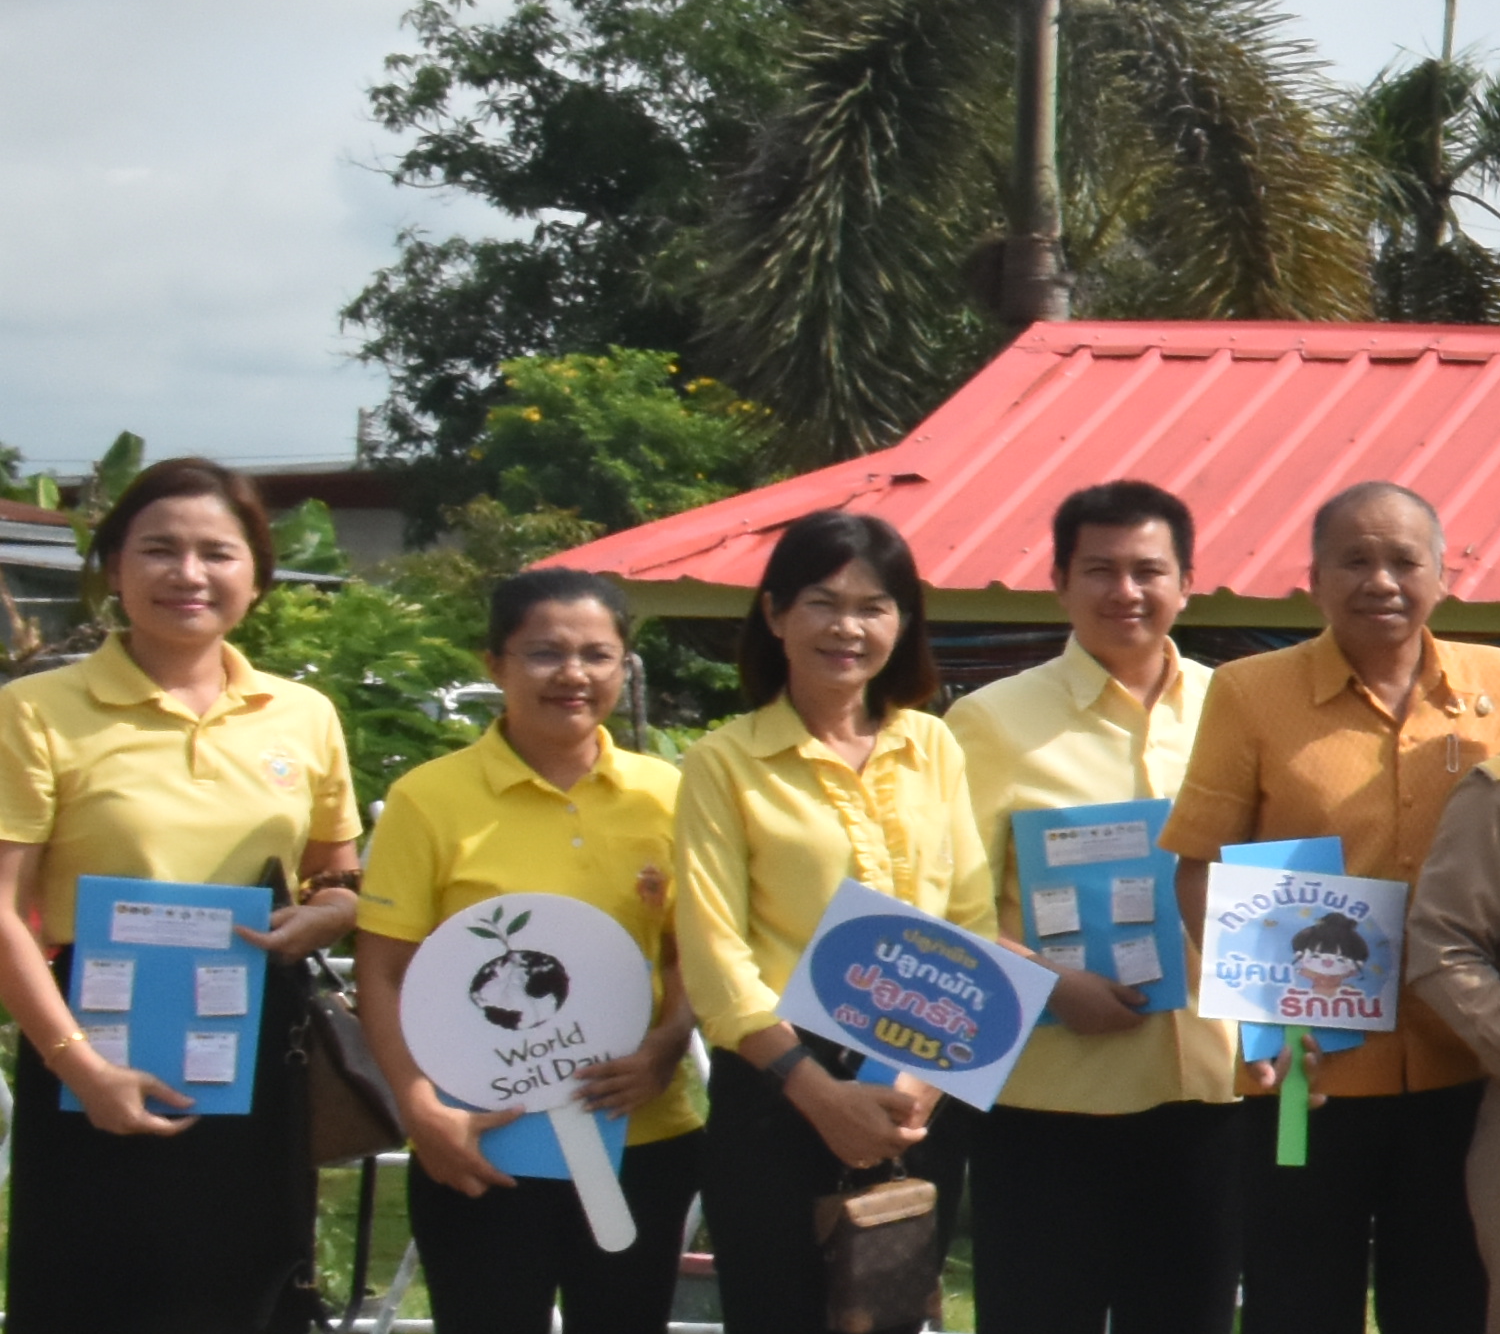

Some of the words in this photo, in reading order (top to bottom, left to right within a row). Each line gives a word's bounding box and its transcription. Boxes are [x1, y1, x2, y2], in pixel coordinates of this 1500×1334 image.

[1217, 874, 1371, 931] ทางนี้มีผล
[1215, 953, 1294, 989] ผู้คน
[1279, 987, 1383, 1019] รักกัน
[494, 1021, 587, 1068] World
[490, 1064, 552, 1101] Soil
